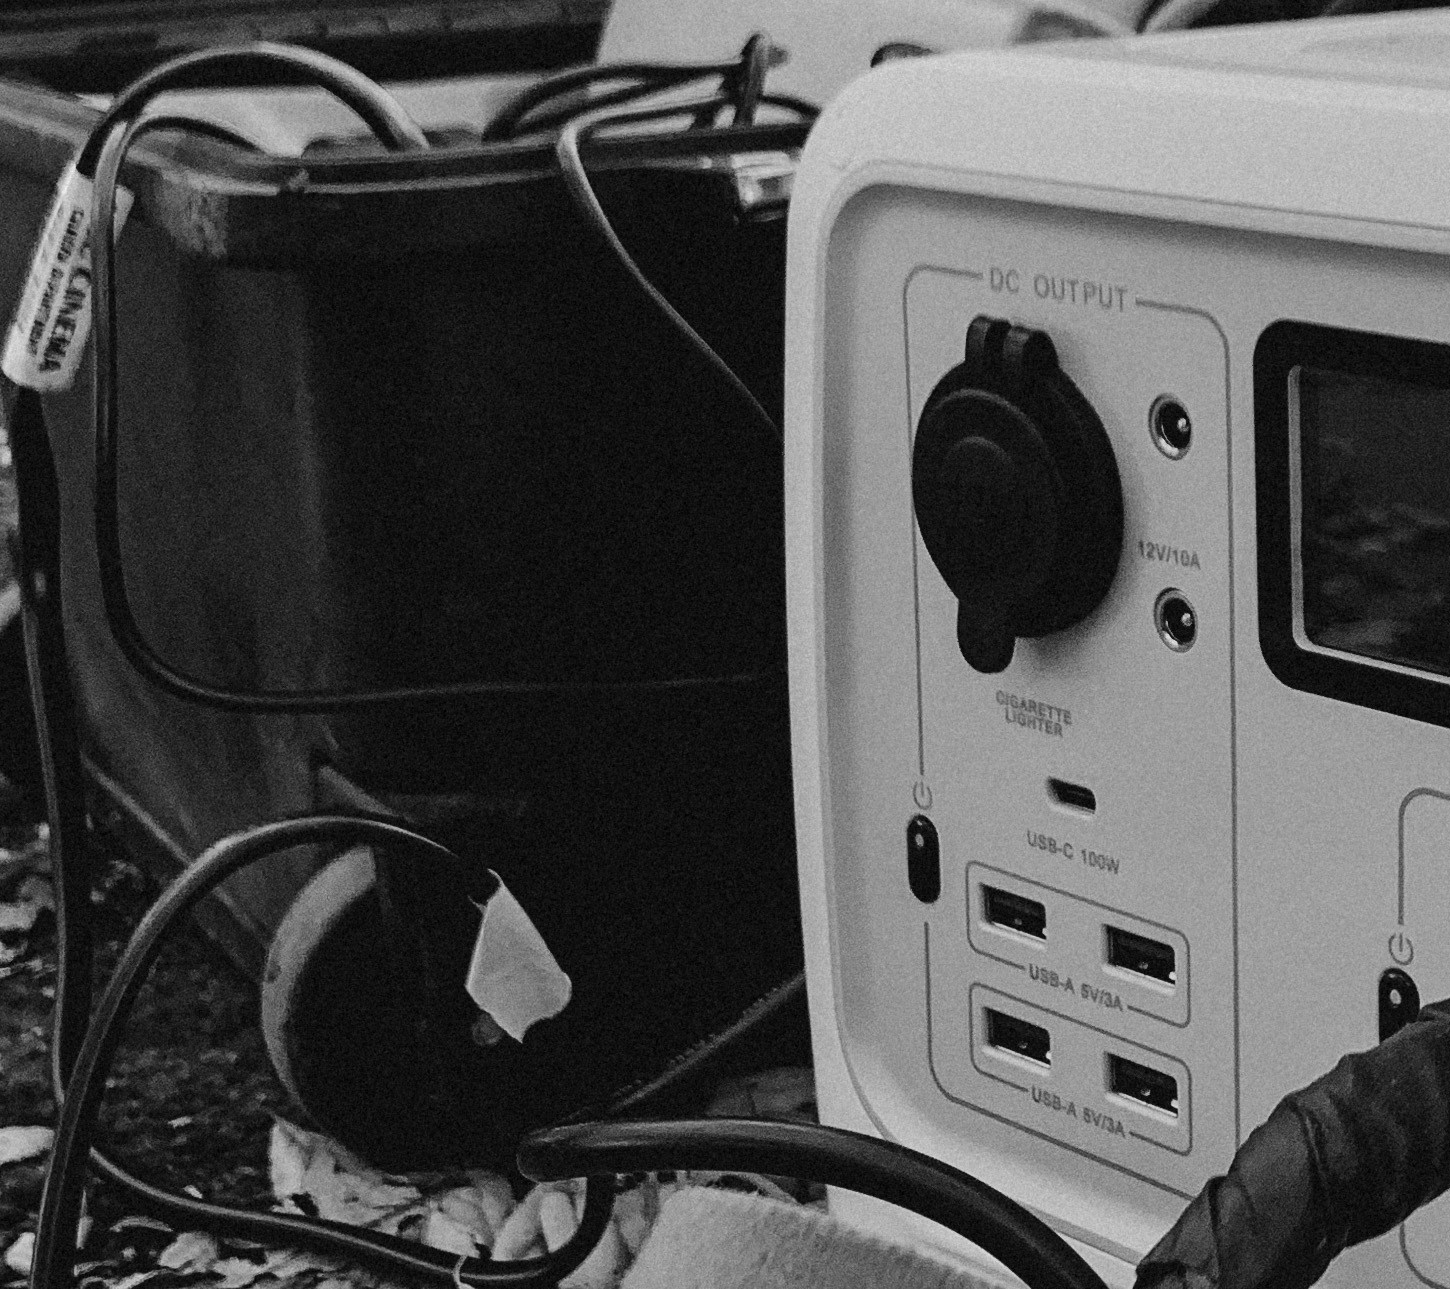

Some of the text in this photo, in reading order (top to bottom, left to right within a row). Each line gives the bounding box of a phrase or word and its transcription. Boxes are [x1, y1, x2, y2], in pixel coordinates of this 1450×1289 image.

[989, 266, 1129, 313] DC OUTPUT
[1137, 539, 1202, 571] 12V/10A
[995, 689, 1073, 725] CIGARETTE
[1005, 707, 1064, 739] LIGHTER
[1026, 830, 1120, 876] USB-C 100W
[1029, 963, 1124, 1012] USB-A 5V/3A
[1031, 1084, 1078, 1119] USB-A
